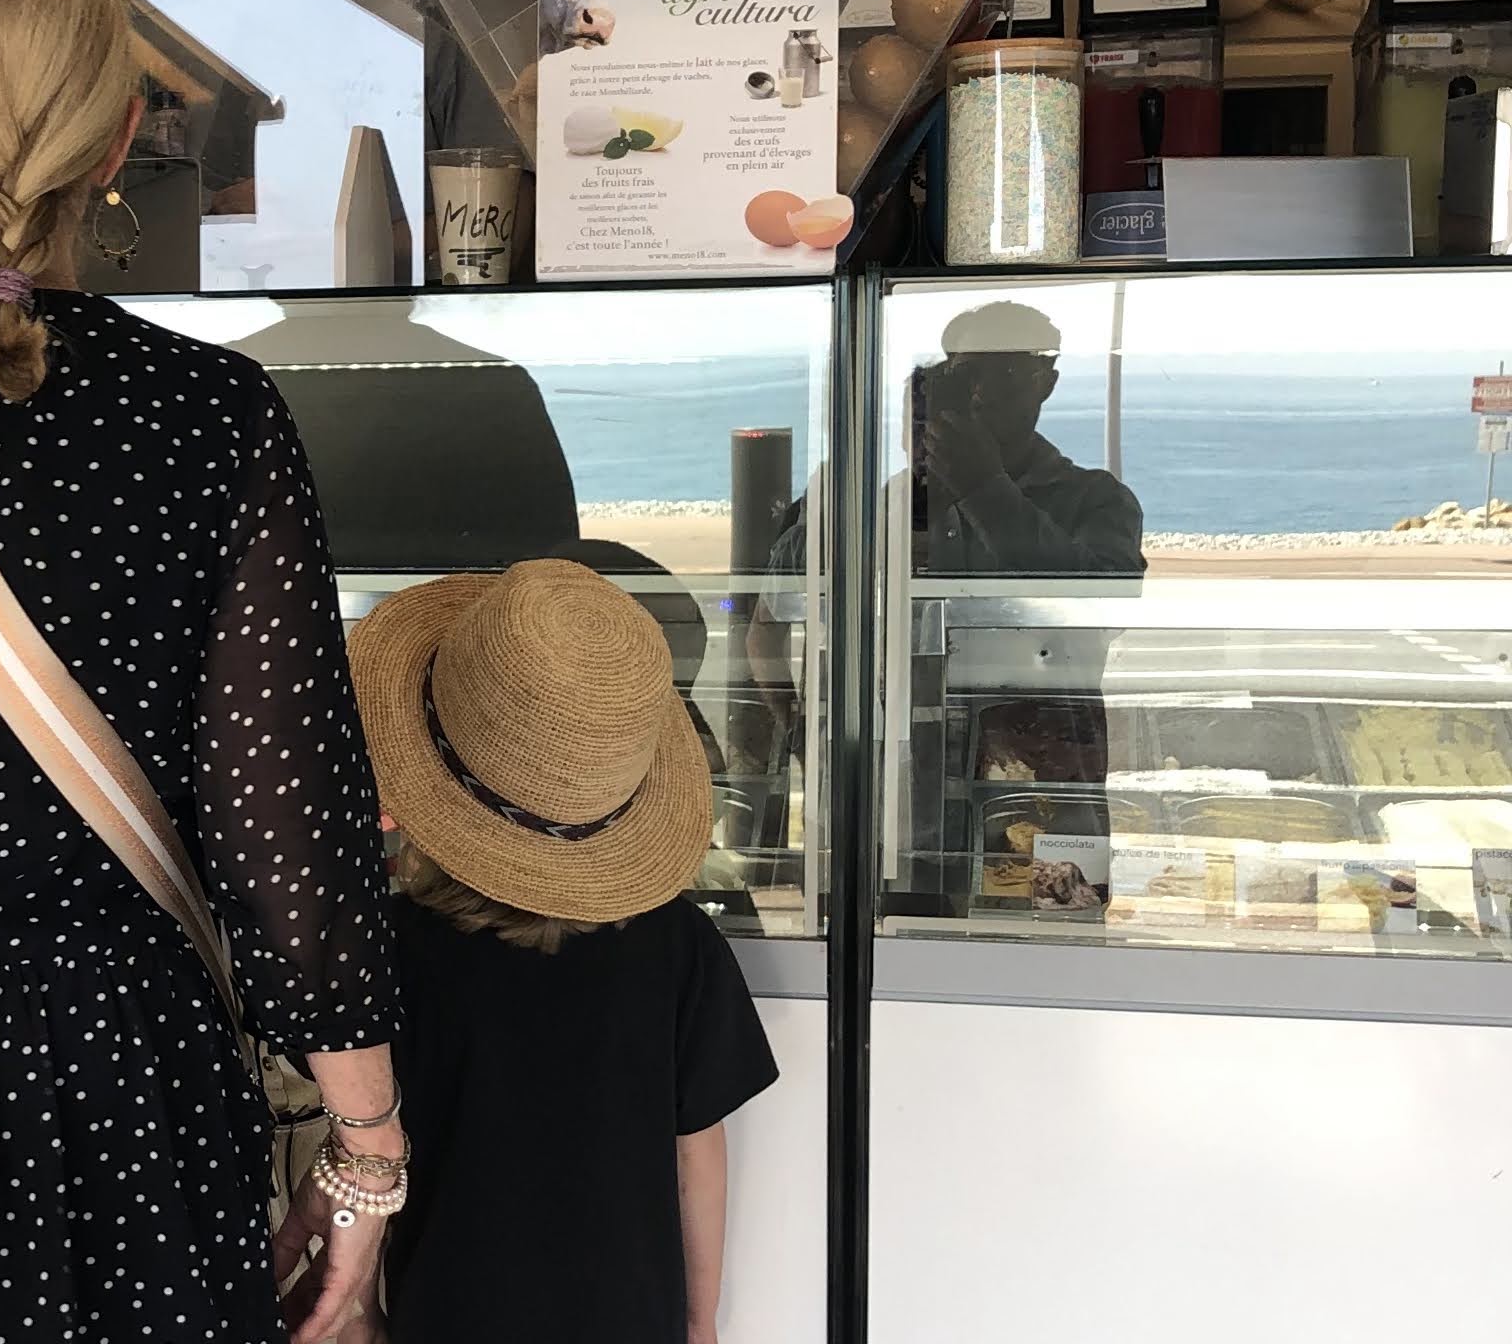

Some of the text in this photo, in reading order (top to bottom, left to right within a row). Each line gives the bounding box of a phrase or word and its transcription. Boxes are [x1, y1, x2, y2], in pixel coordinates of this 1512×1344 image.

[702, 146, 812, 163] provenant d'élevages
[595, 165, 643, 179] Toujours
[581, 175, 655, 188] des fruits frais
[1099, 210, 1155, 235] glacier
[1039, 838, 1096, 850] nocciolata
